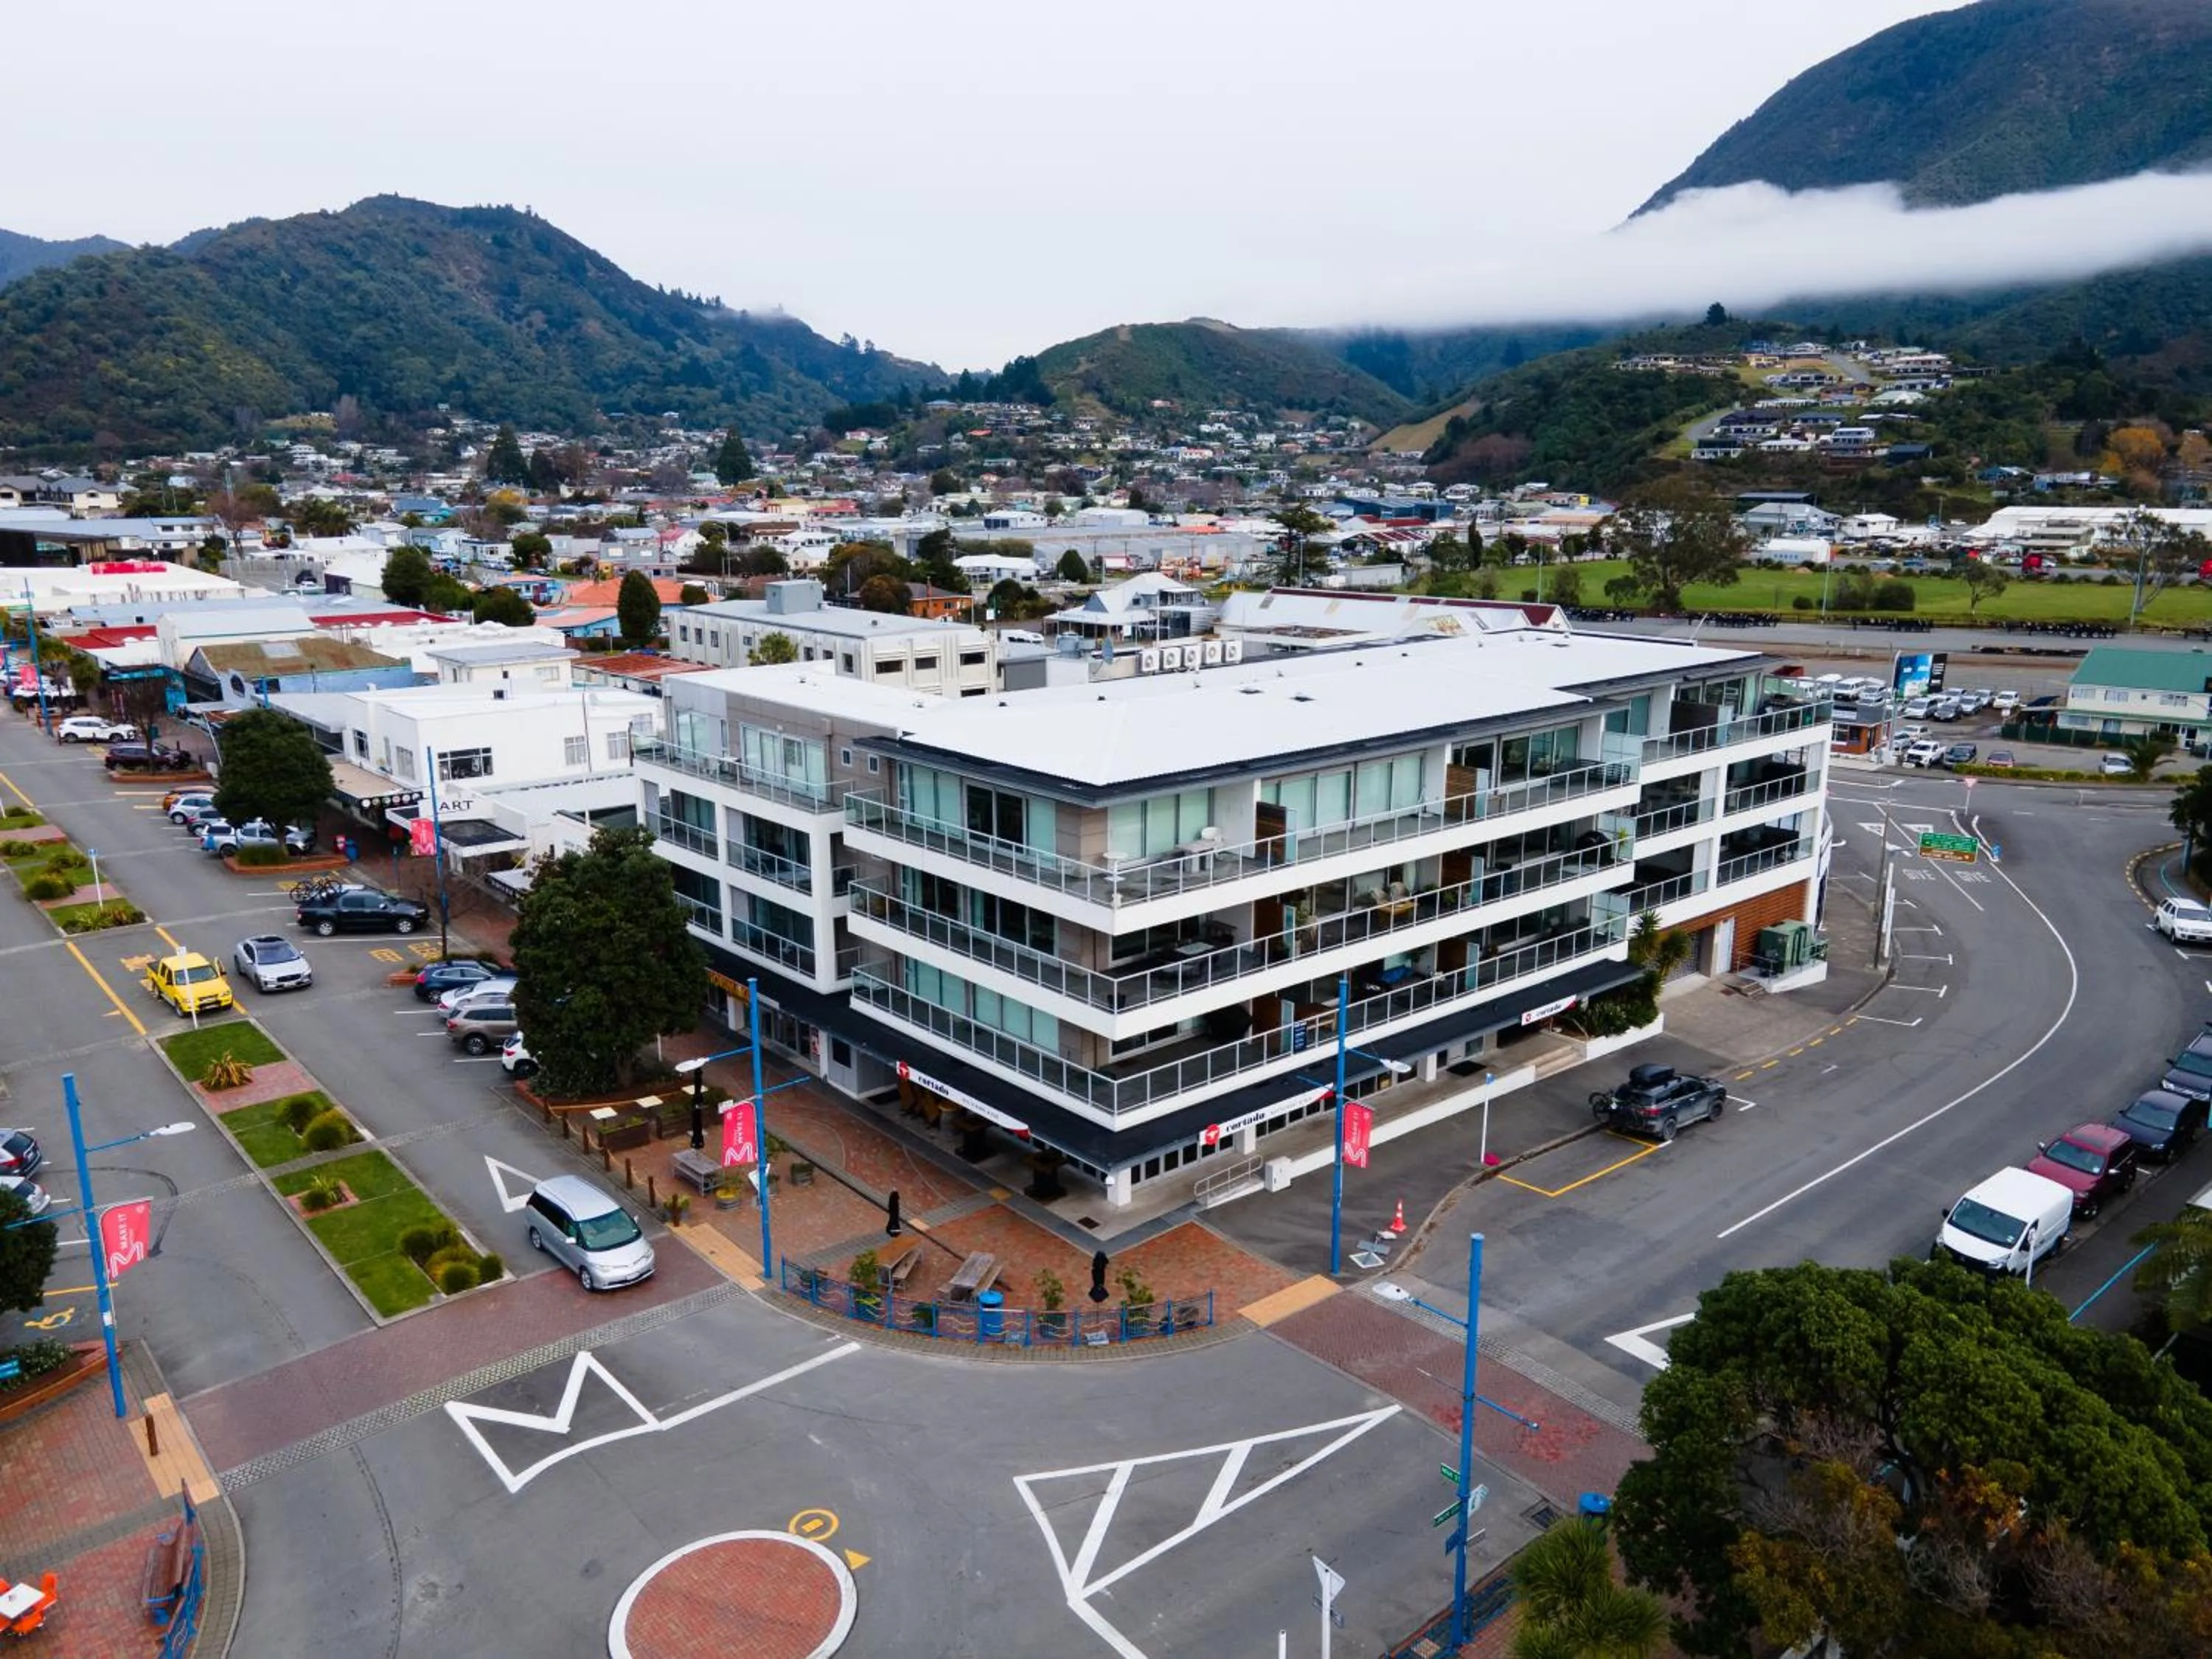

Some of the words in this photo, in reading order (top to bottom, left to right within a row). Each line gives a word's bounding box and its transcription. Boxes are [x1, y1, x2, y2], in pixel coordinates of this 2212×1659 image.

[439, 800, 474, 811] ART
[918, 1075, 950, 1096] cortado
[1225, 1112, 1265, 1133] cortado
